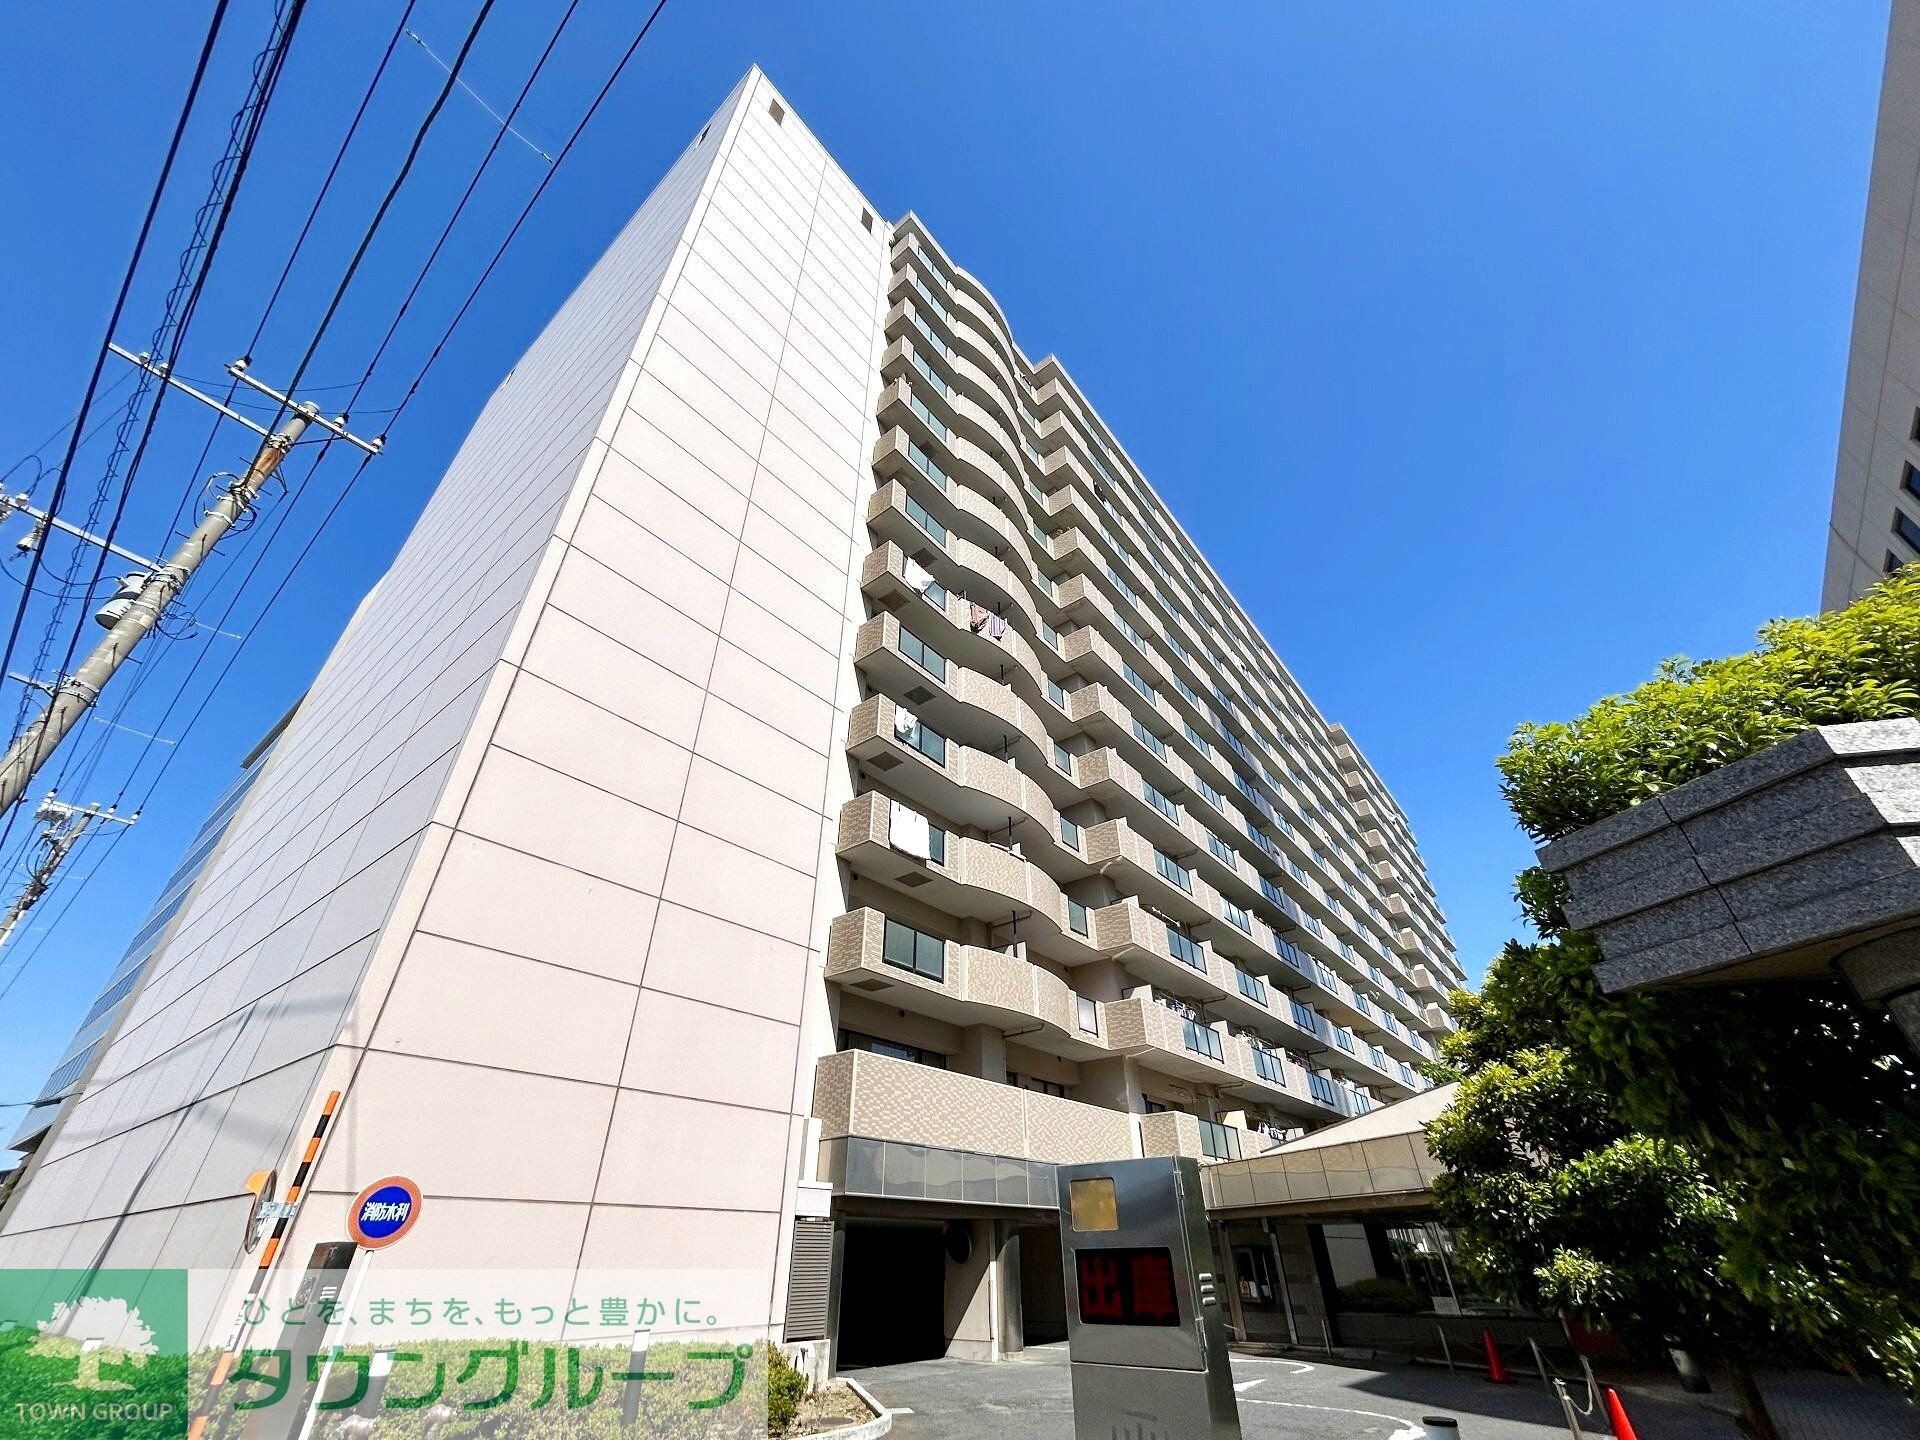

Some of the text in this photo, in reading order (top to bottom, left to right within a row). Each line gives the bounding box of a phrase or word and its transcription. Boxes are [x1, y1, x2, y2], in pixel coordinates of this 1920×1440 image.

[360, 1201, 410, 1222] 消防水利
[1079, 1253, 1175, 1320] 出庫
